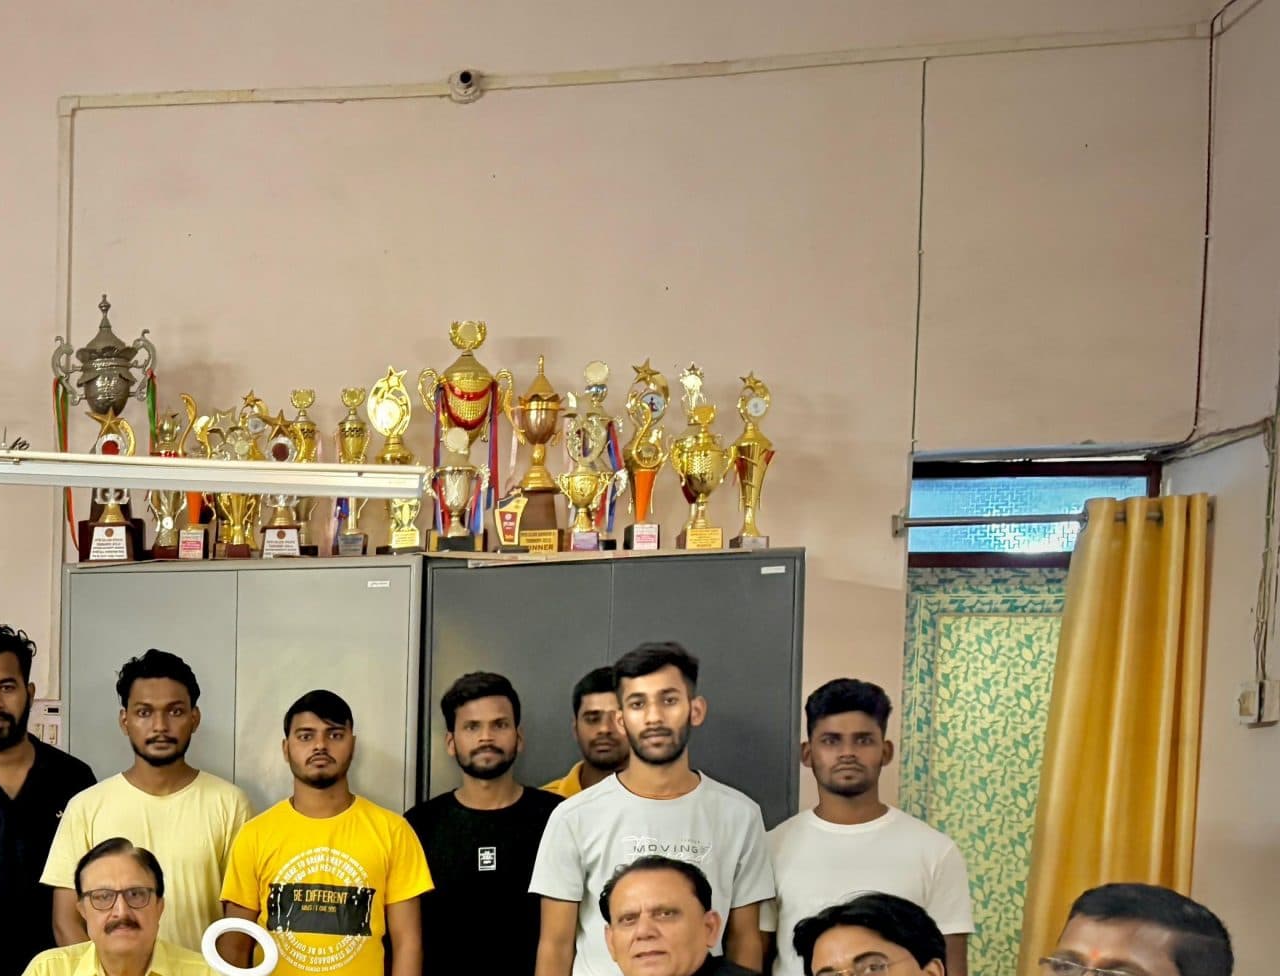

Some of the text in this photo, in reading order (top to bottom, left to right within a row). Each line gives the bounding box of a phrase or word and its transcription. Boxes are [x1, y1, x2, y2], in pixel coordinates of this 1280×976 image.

[528, 543, 554, 551] INNER
[633, 844, 699, 854] MOVING
[294, 889, 348, 905] BE DIFFERENT
